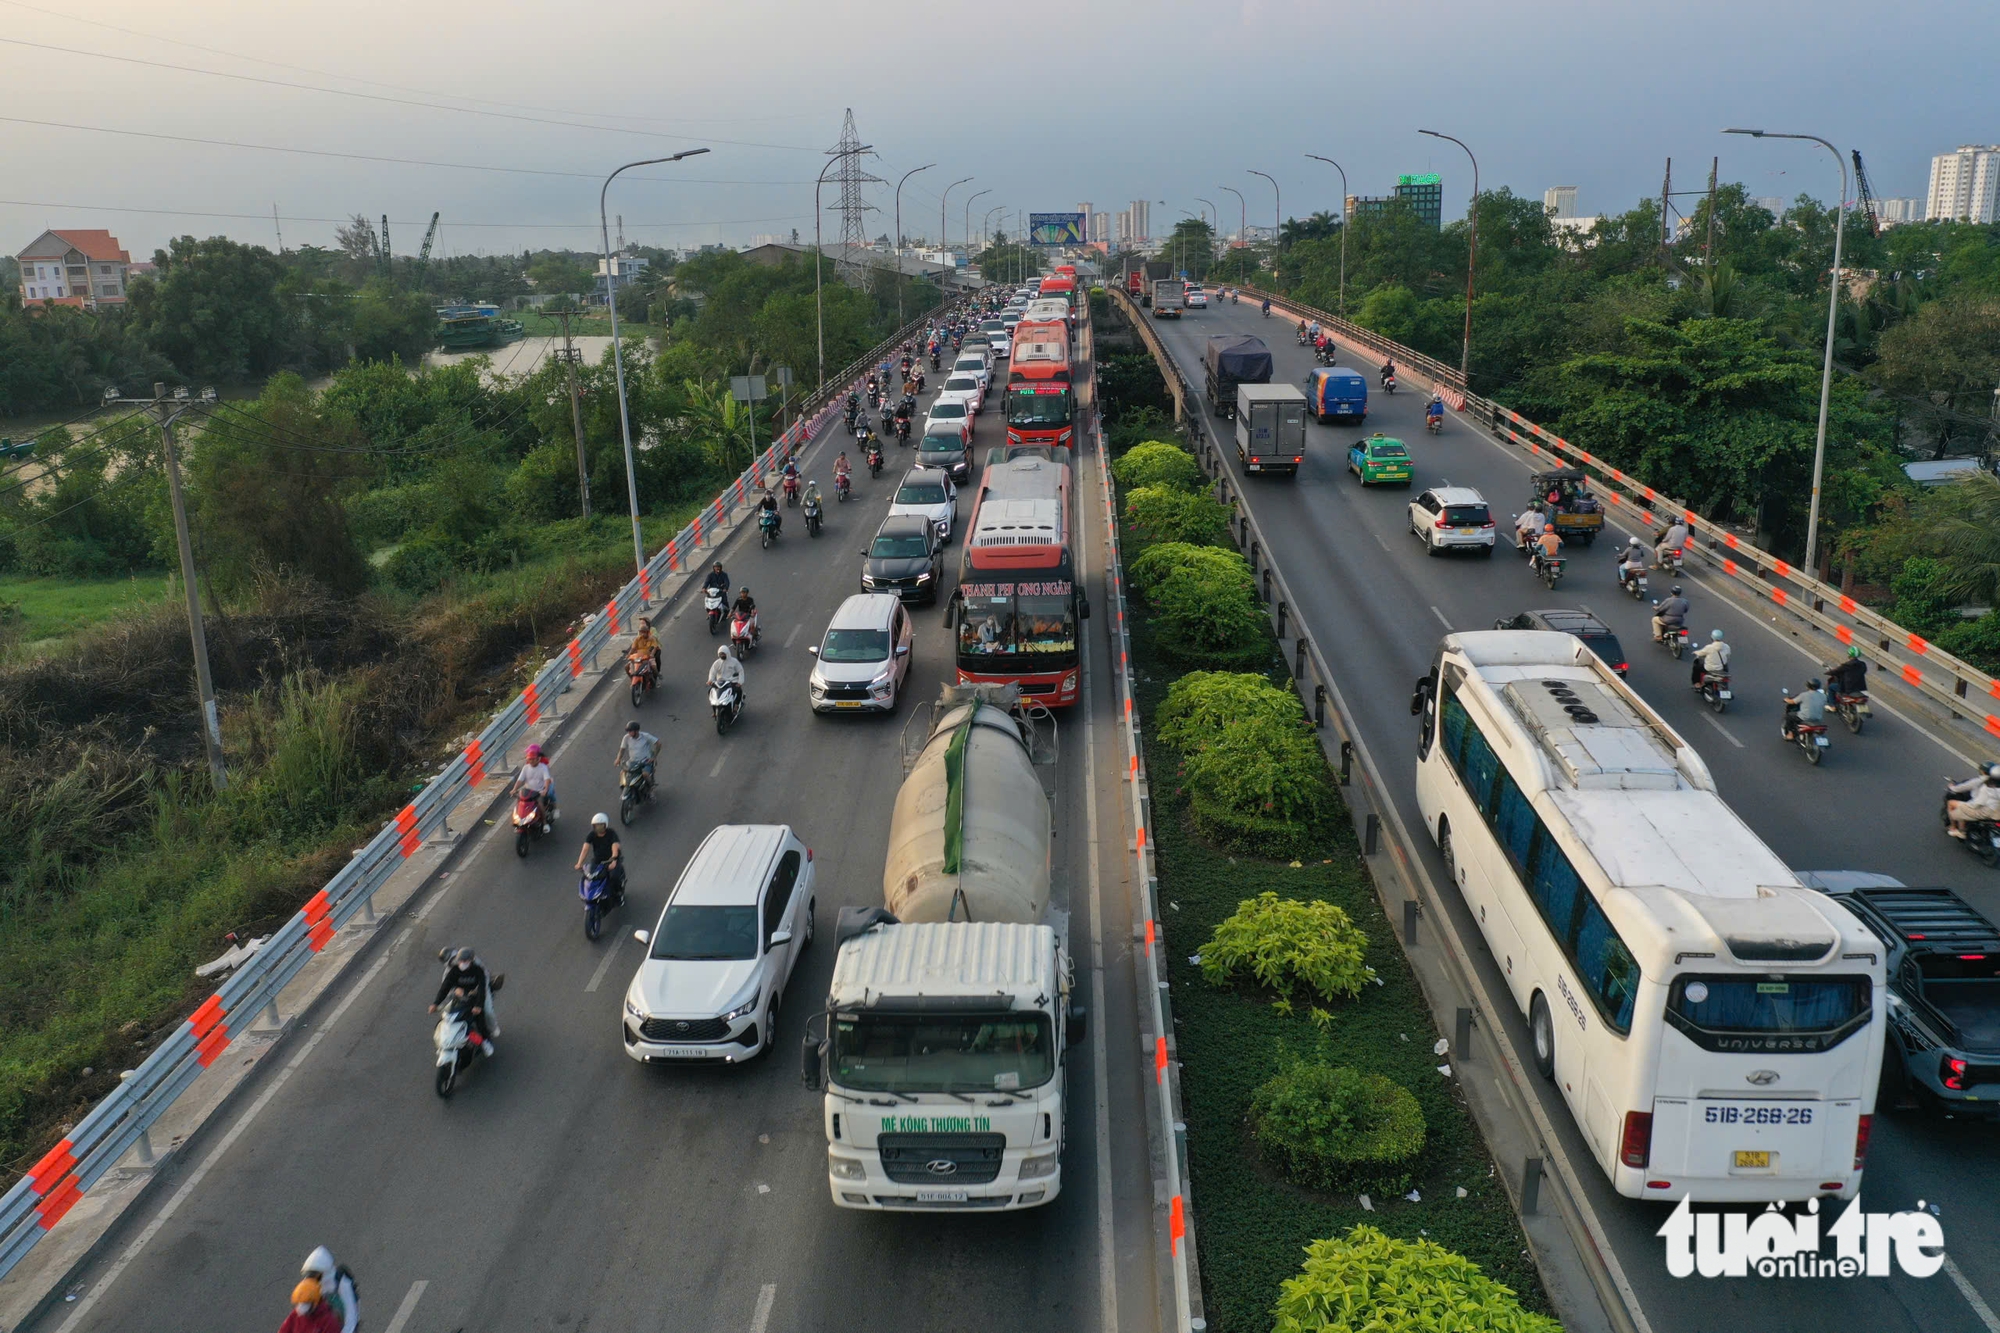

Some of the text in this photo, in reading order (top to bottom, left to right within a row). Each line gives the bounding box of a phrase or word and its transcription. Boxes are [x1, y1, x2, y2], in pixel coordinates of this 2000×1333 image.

[961, 583, 996, 597] THANH
[881, 1116, 898, 1132] MÊ
[900, 1115, 928, 1132] KÔNG
[974, 1115, 990, 1132] TÍN
